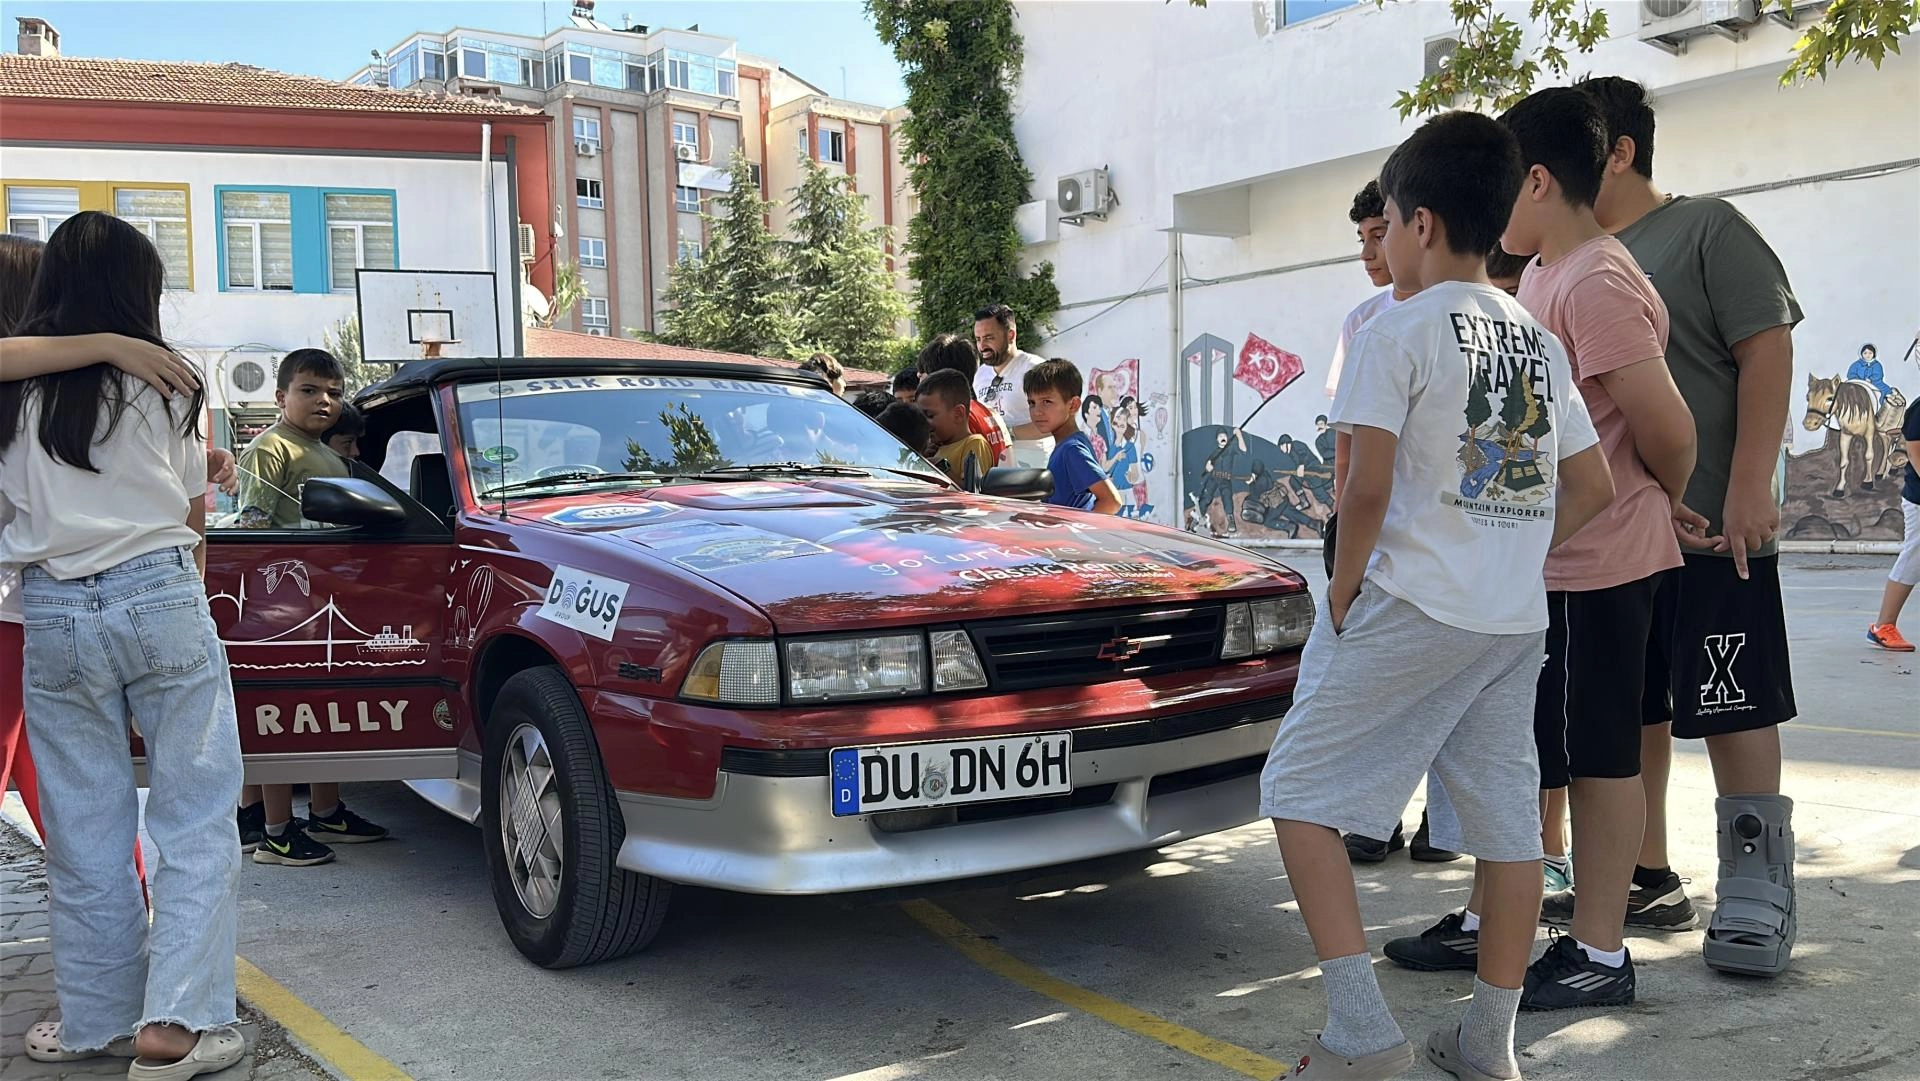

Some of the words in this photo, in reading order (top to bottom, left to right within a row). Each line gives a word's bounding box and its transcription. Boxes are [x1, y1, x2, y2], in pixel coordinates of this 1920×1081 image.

[1449, 313, 1550, 362] EXTREME
[526, 377, 602, 391] SILK
[616, 377, 695, 388] ROAD
[709, 379, 792, 395] RALLY
[1459, 347, 1554, 403] TRAVEL
[1494, 505, 1546, 518] EXPLORER
[958, 562, 1064, 582] Classic
[1061, 561, 1165, 574] Remise
[1701, 632, 1746, 706] X
[255, 700, 409, 736] RALLY
[860, 752, 920, 804] DU
[950, 744, 1006, 796] DN
[1015, 740, 1067, 788] 6H
[841, 788, 852, 803] D
